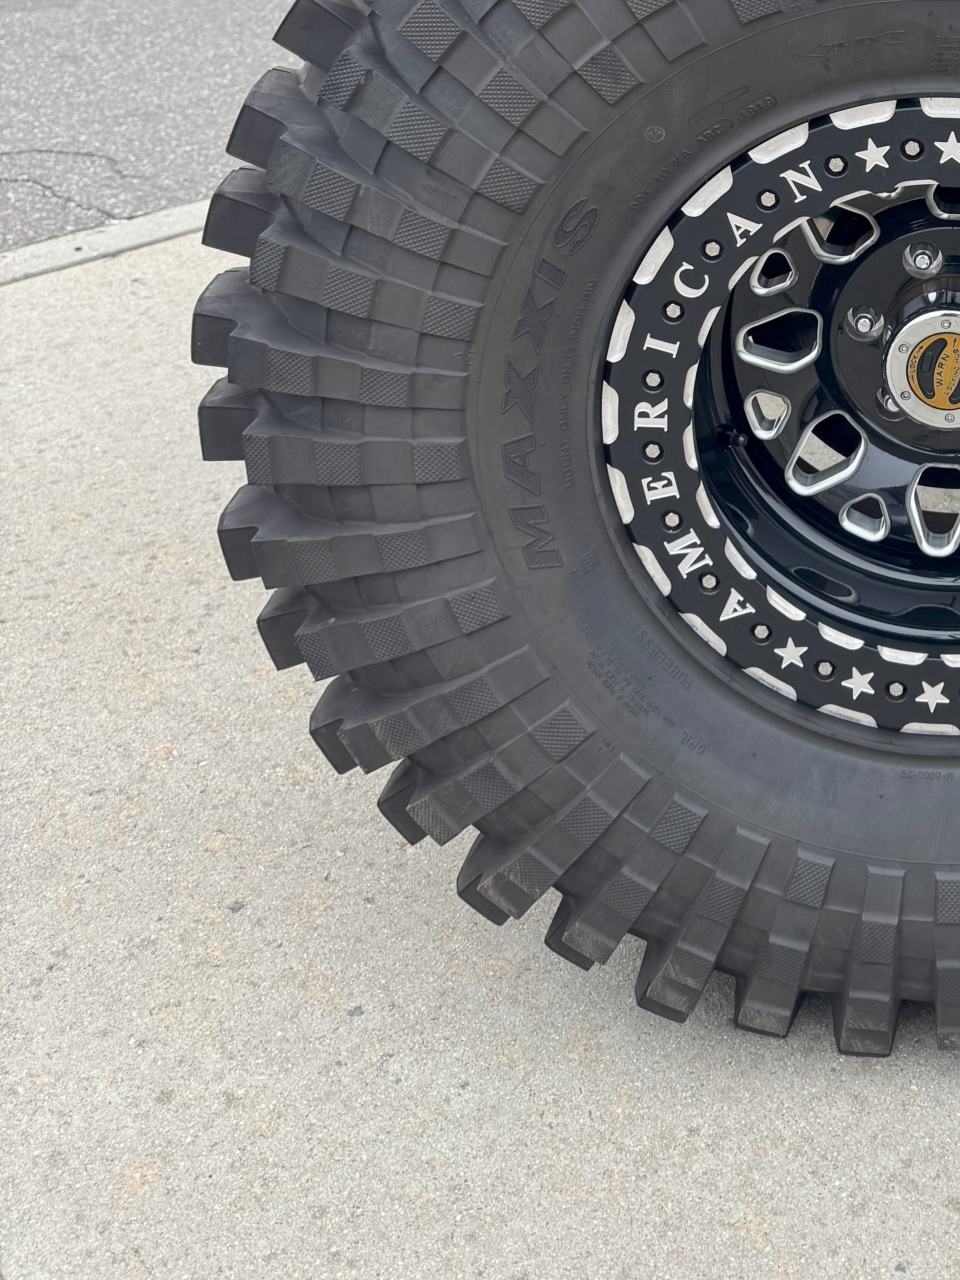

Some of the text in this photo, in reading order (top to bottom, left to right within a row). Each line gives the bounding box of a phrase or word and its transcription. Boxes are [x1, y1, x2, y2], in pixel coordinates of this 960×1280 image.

[647, 127, 663, 141] 74
[629, 187, 653, 212] DOT
[697, 124, 723, 145] ABC
[501, 197, 599, 569] MAXXIS
[558, 278, 598, 489] MOUNT ONLY ON 17 INCH RIM
[632, 161, 825, 624] AMERICAN
[910, 354, 919, 373] LOCK
[936, 352, 950, 388] WARN
[942, 348, 960, 396] LOCKING HUB
[635, 629, 695, 692] TUBELESS
